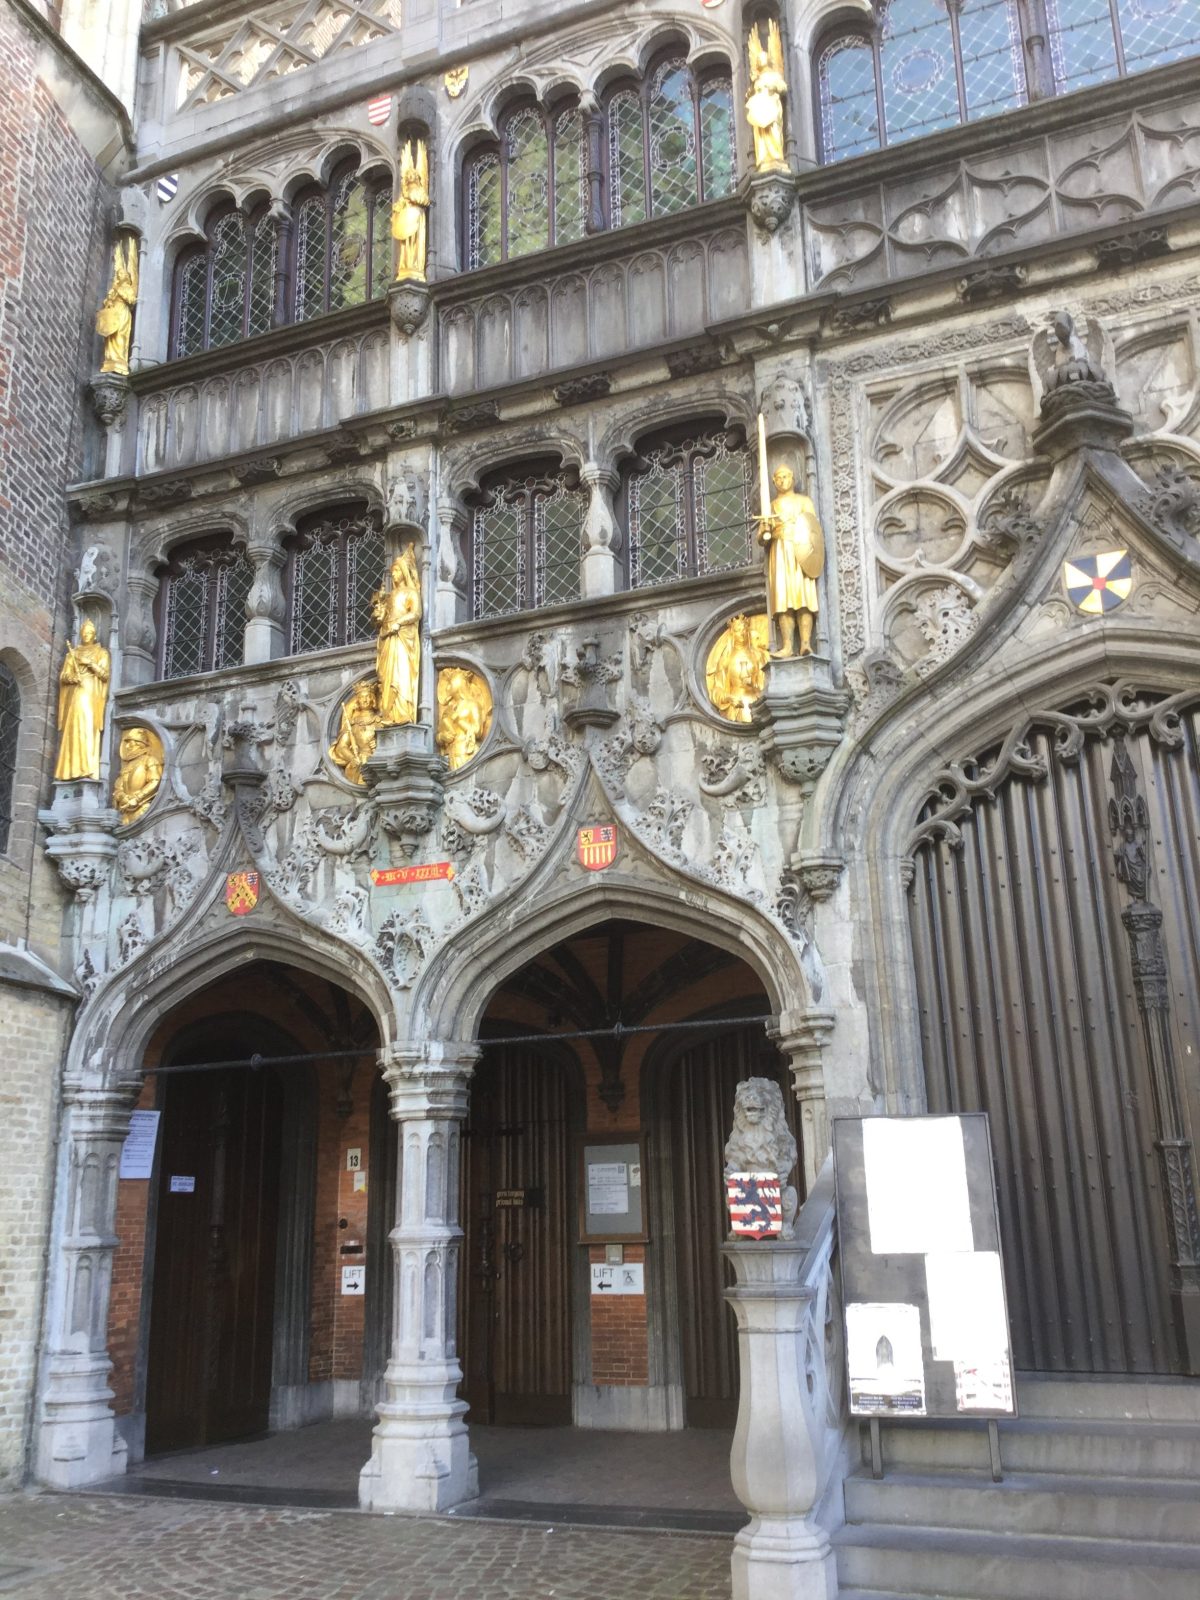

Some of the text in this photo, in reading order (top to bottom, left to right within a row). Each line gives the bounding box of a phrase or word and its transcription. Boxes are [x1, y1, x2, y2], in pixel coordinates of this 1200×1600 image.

[350, 1155, 359, 1167] 13
[343, 1268, 363, 1279] LIFT
[593, 1267, 614, 1278] LIFT
